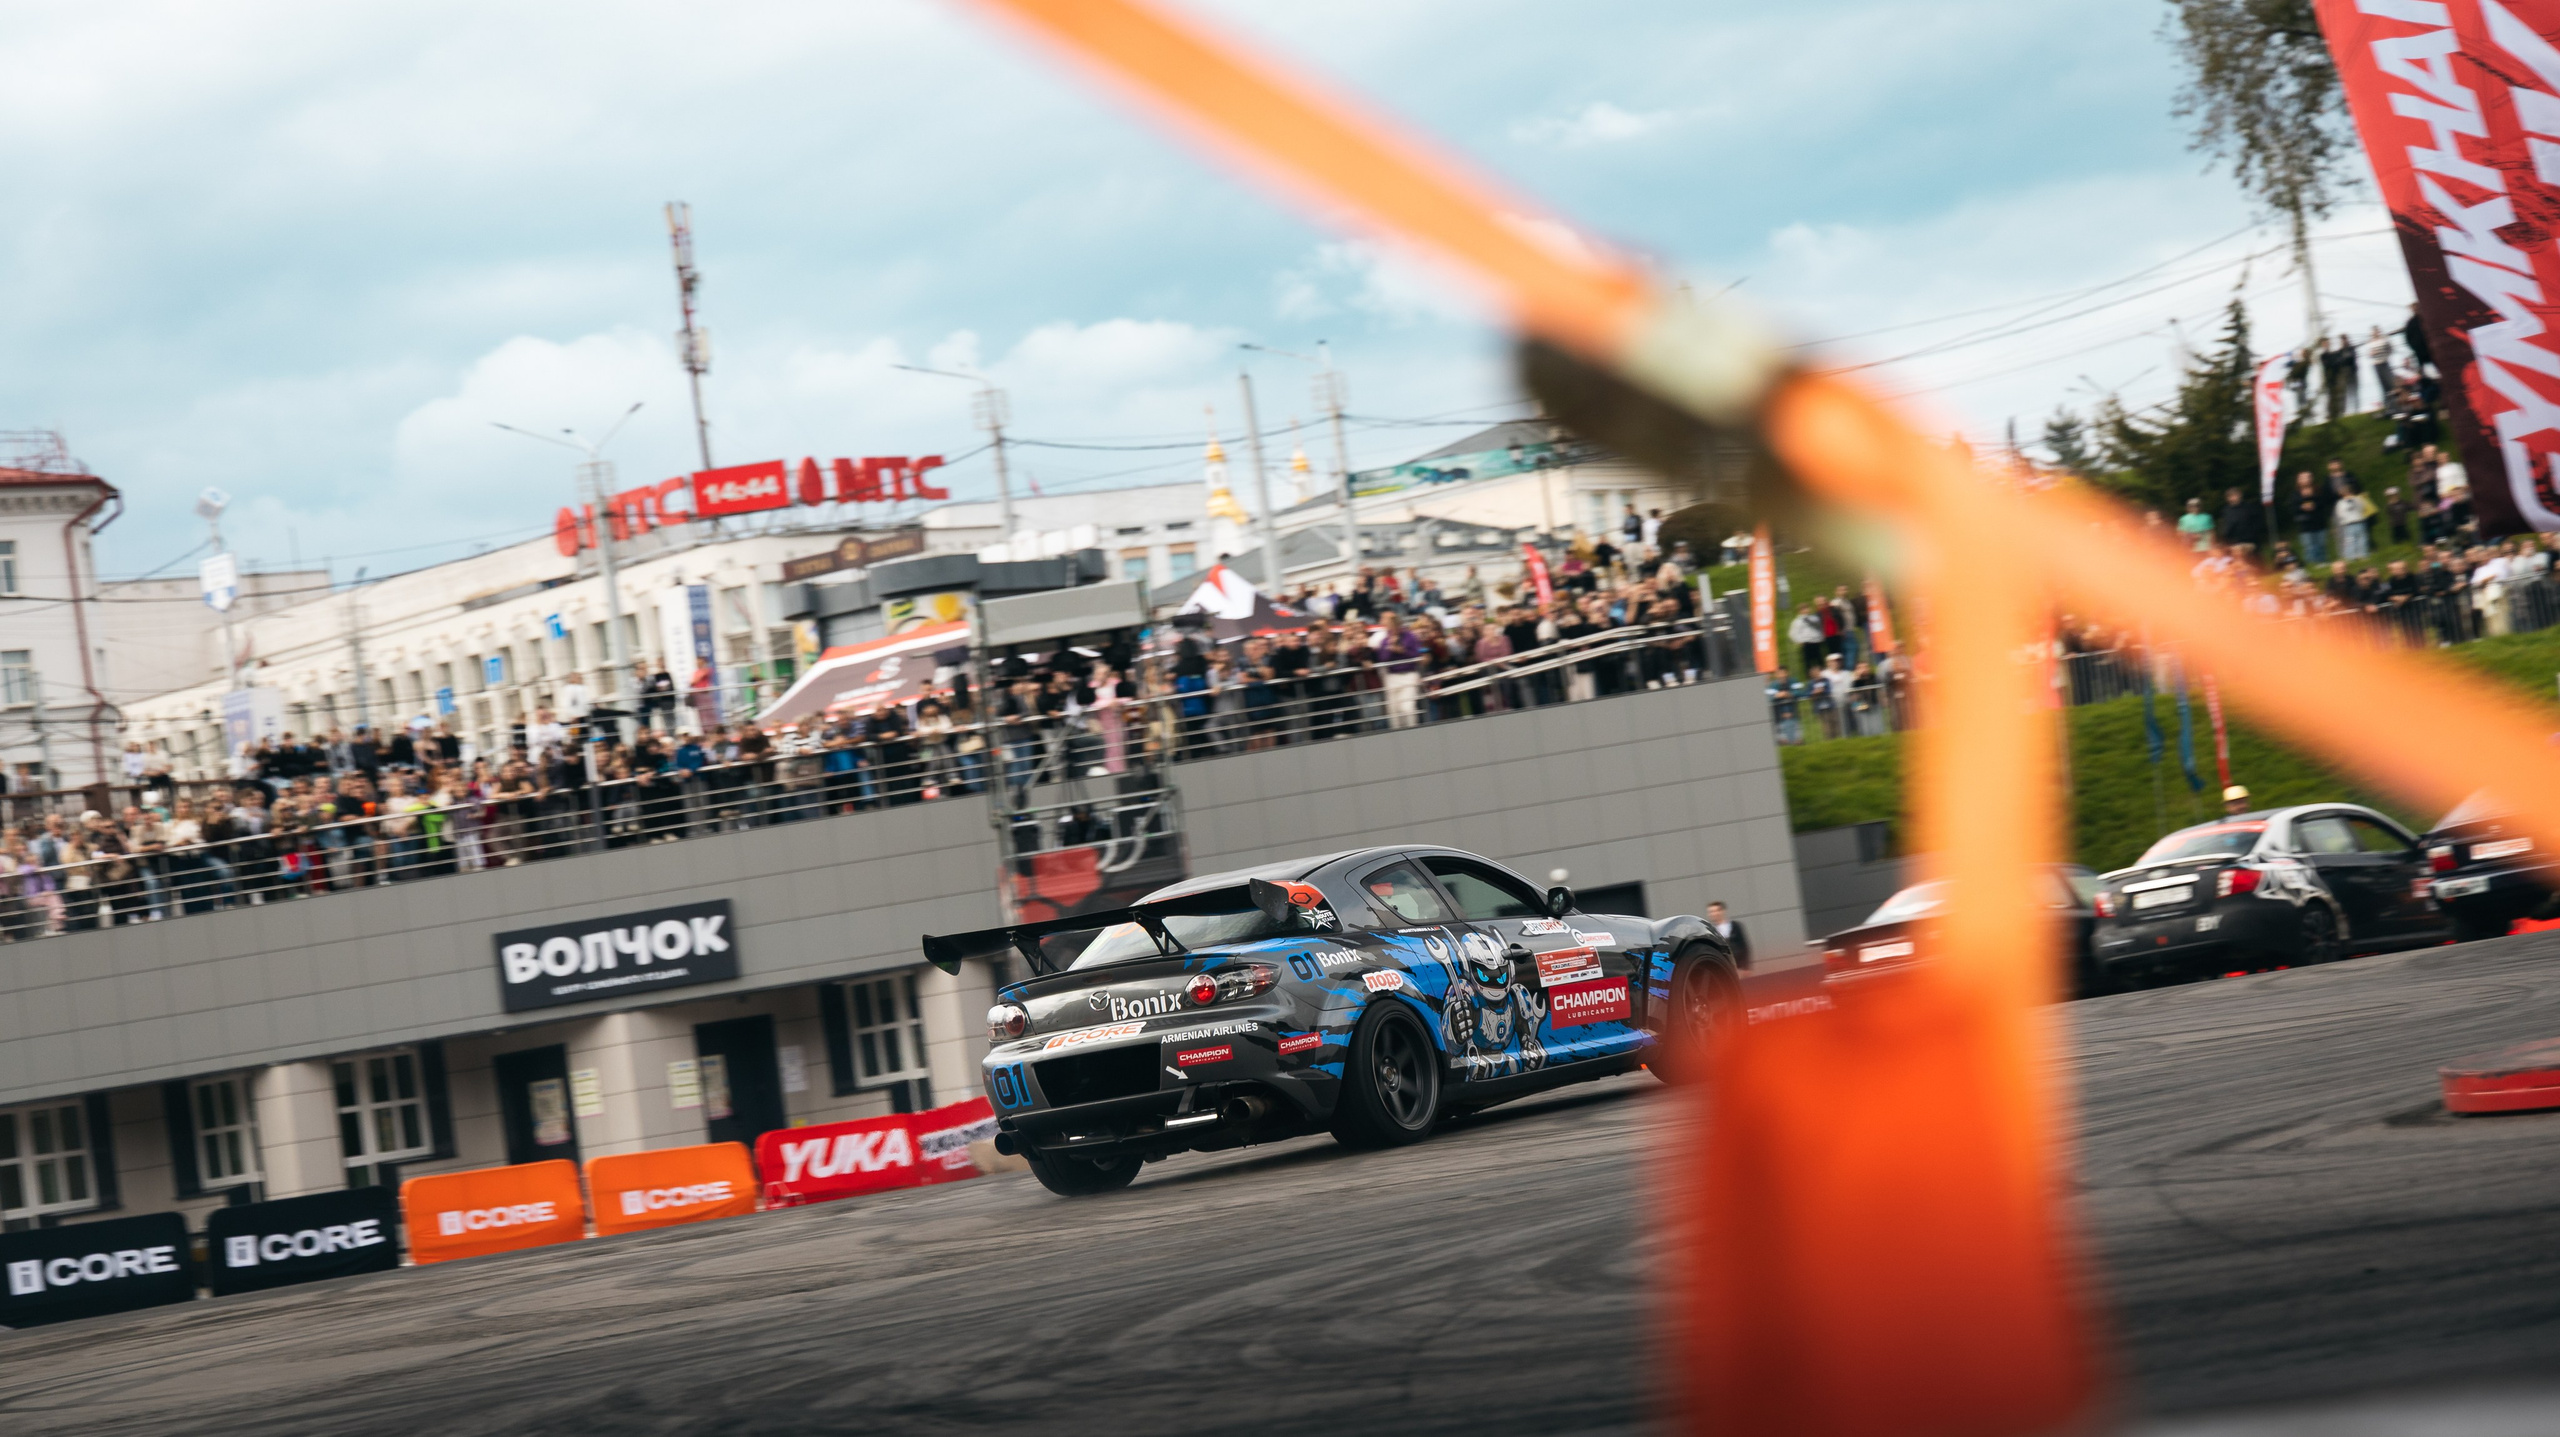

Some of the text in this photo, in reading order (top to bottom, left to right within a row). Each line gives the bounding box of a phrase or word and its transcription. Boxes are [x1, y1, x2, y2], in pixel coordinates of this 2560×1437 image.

[702, 474, 781, 505] 14:44
[833, 455, 949, 503] МТС
[501, 915, 730, 984] ВОЛЧОК
[1287, 947, 1362, 983] 01 Bonix
[1110, 992, 1182, 1021] Bonix
[1553, 987, 1626, 1011] CHAMPION
[1567, 1006, 1615, 1019] LUBRICANTS
[1161, 1022, 1259, 1044] ARMENIAN AIRLINES
[1280, 1035, 1319, 1049] CHAMPION
[1179, 1048, 1229, 1061] CHAMPION
[991, 1061, 1034, 1110] 01
[779, 1128, 914, 1183] YUKA
